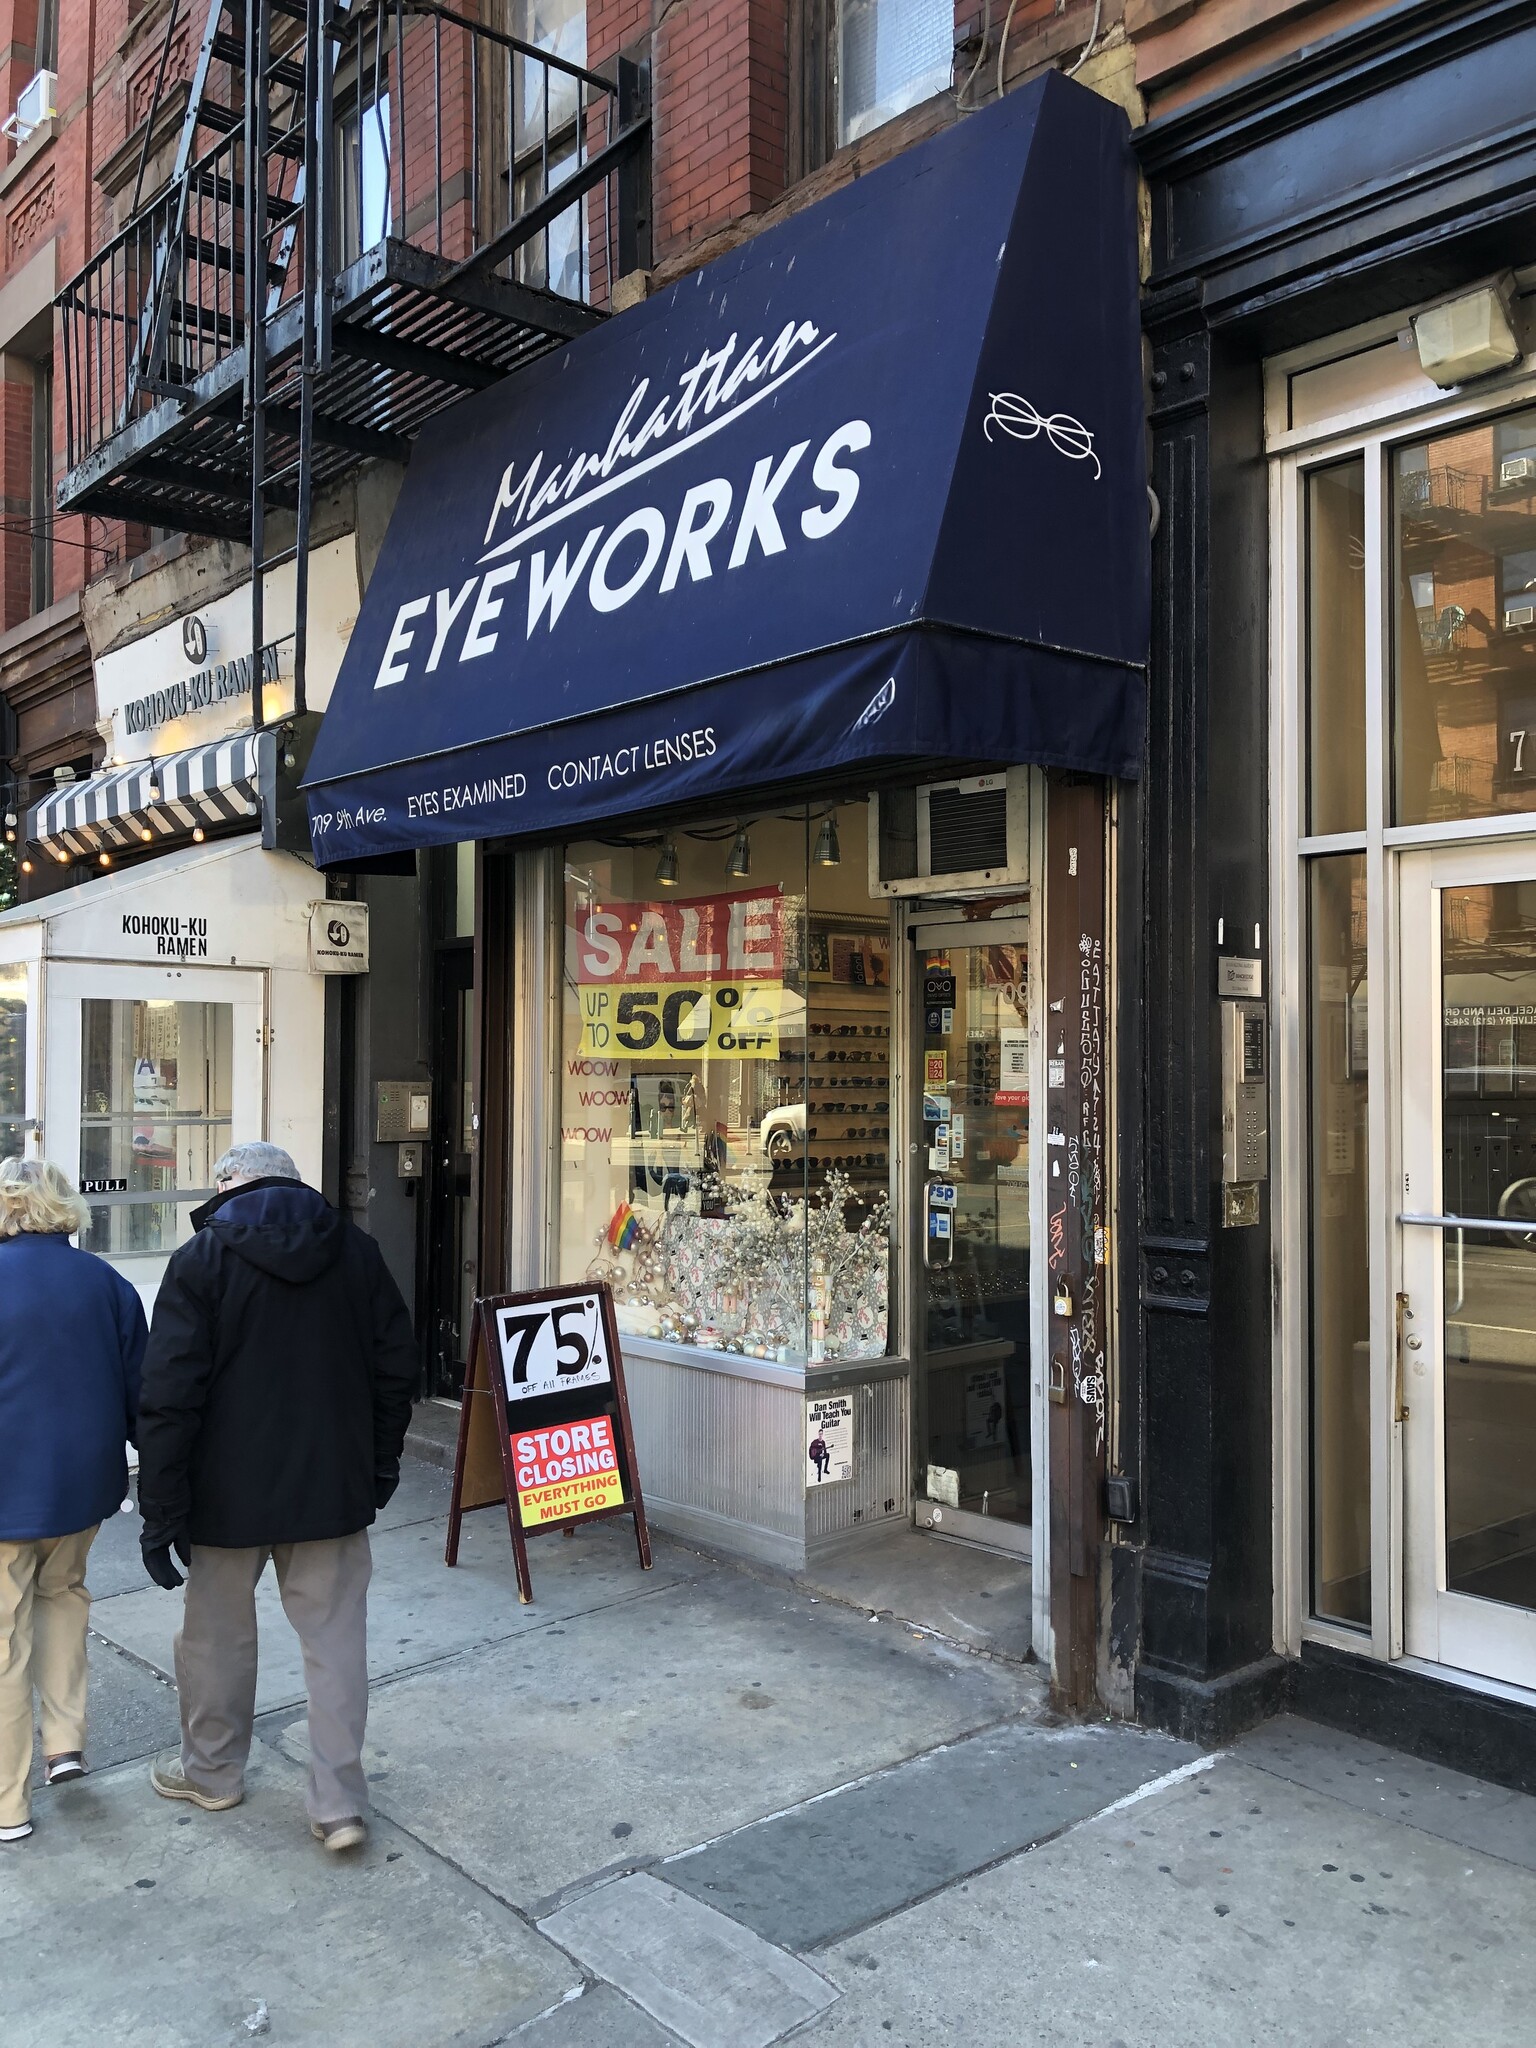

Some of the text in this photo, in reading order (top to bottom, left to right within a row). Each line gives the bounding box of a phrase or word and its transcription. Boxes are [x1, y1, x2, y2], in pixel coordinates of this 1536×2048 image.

[483, 319, 820, 546] Manhattan
[373, 419, 872, 690] EYEWORKS
[124, 645, 280, 735] KOHOKU-KU RAMN
[312, 727, 717, 838] 709 9th Ave. EYES EXAMINED CONTACT LENSES
[122, 915, 208, 938] KOHOKU-KU
[582, 900, 774, 977] SALE
[157, 936, 208, 957] RAMEN
[586, 992, 609, 1017] UP
[615, 987, 773, 1051] 50%
[587, 1023, 610, 1049] TO
[717, 1032, 773, 1050] OFF
[567, 1061, 619, 1076] WOOW
[579, 1091, 629, 1107] WOOW
[995, 1093, 1006, 1101] love
[561, 1127, 613, 1144] WOOW
[84, 1179, 125, 1192] PULL
[503, 1299, 603, 1384] 75%
[521, 1382, 538, 1394] OFF
[559, 1371, 602, 1386] FRAMES
[809, 1408, 851, 1422] Will Teach You
[814, 1399, 847, 1412] Dan Smith
[821, 1419, 841, 1429] Guitar
[517, 1420, 610, 1464] STORE
[518, 1448, 615, 1488] CLOSING
[523, 1474, 618, 1507] EVERYTHING
[540, 1493, 607, 1520] MUST GO
